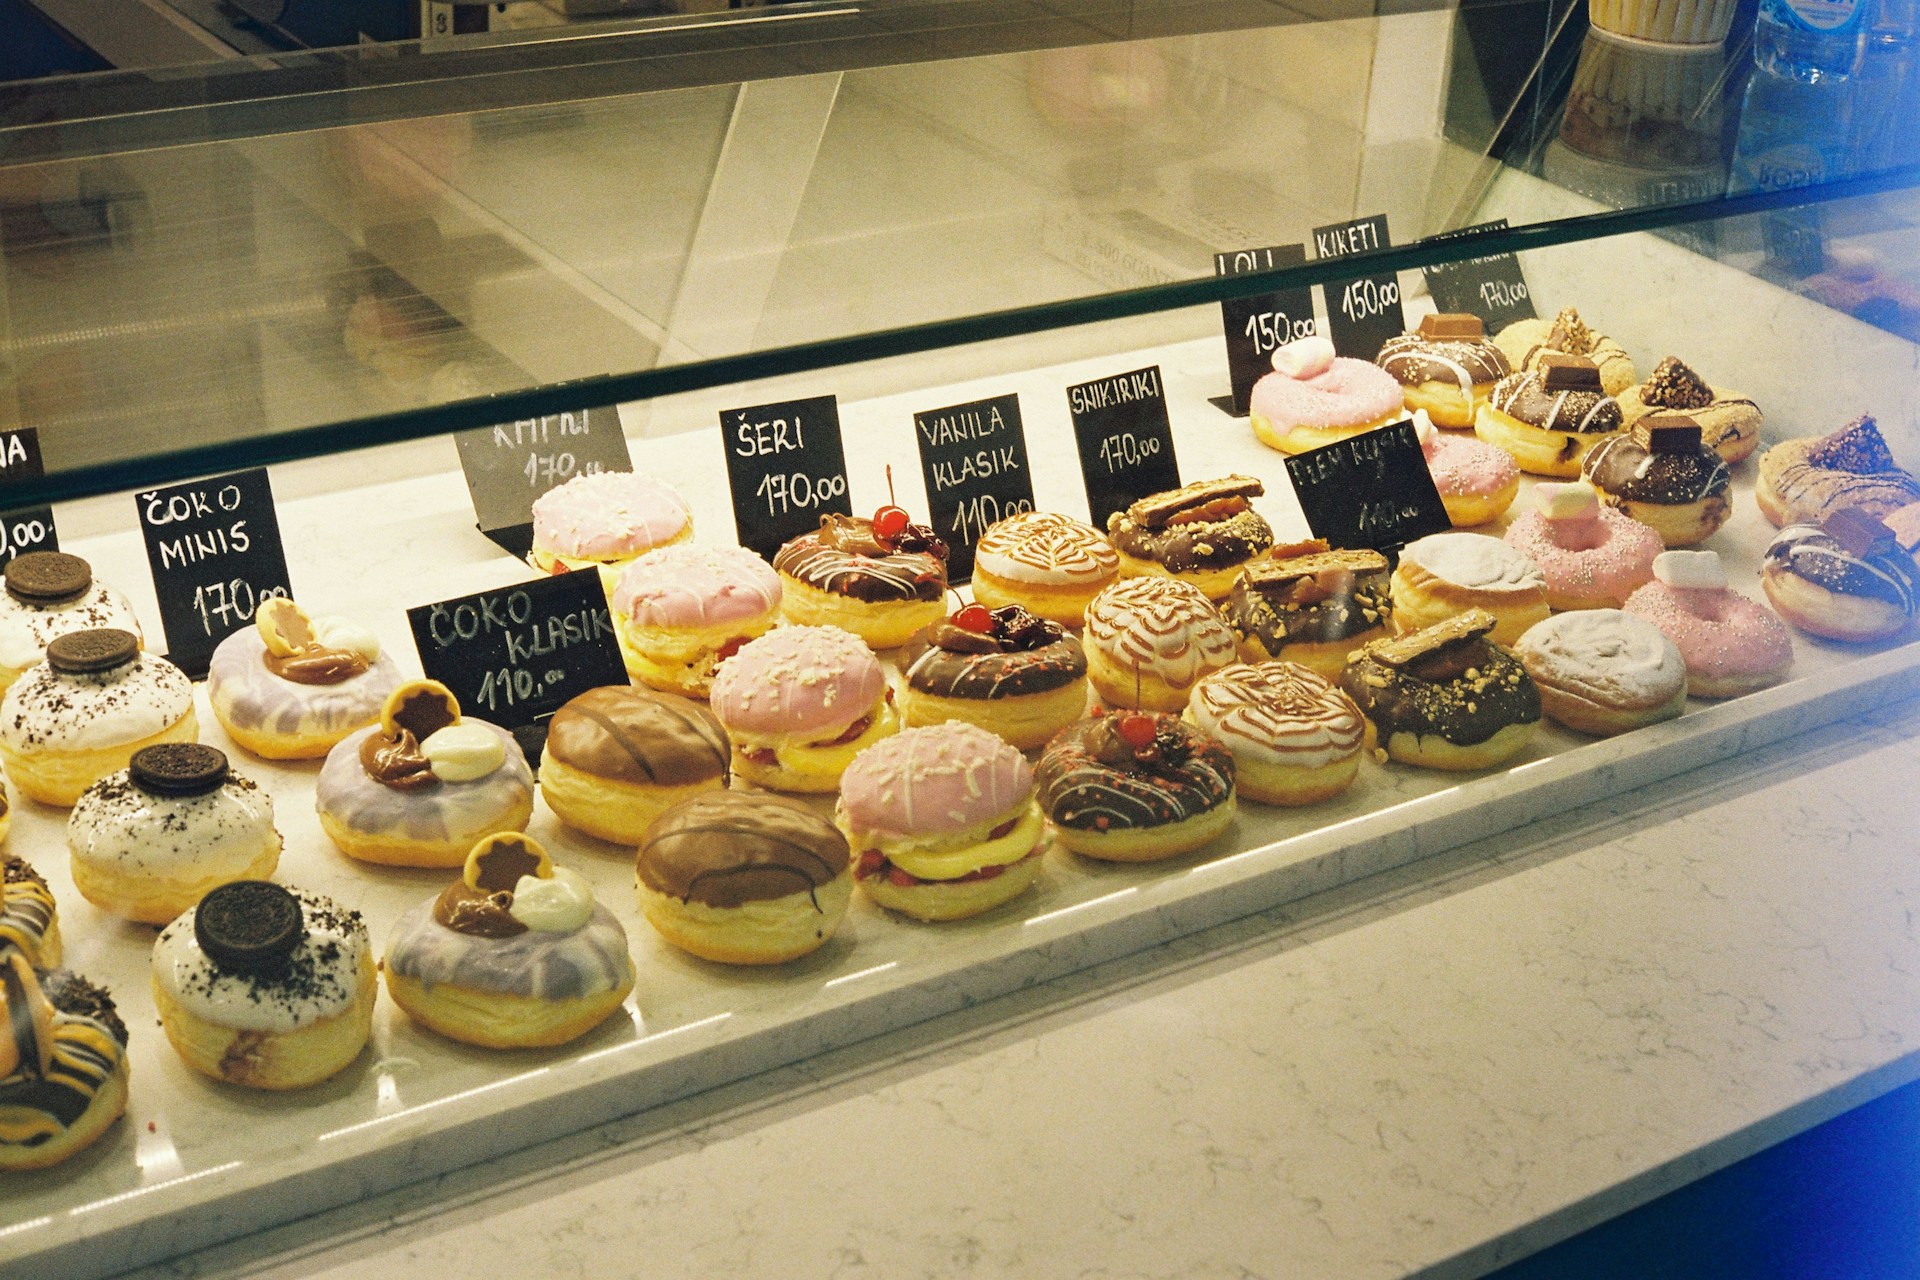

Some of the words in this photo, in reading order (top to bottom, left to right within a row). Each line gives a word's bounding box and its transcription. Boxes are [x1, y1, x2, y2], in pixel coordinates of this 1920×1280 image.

[1317, 223, 1378, 259] KIKETI
[1342, 279, 1399, 323] 150,00
[1480, 280, 1527, 311] 170,00
[1245, 312, 1315, 355] 150,00
[1071, 370, 1160, 414] SNIKIRIKI
[736, 412, 804, 457] ŠERI
[919, 406, 1005, 446] VANILA
[932, 446, 1019, 491] KLASIK
[1100, 433, 1160, 473] 170,00
[143, 485, 241, 525] ČOKO
[756, 472, 846, 517] 170,00
[159, 520, 250, 569] MINIS
[430, 590, 532, 647] ČOKO
[505, 608, 613, 665] KLASIK
